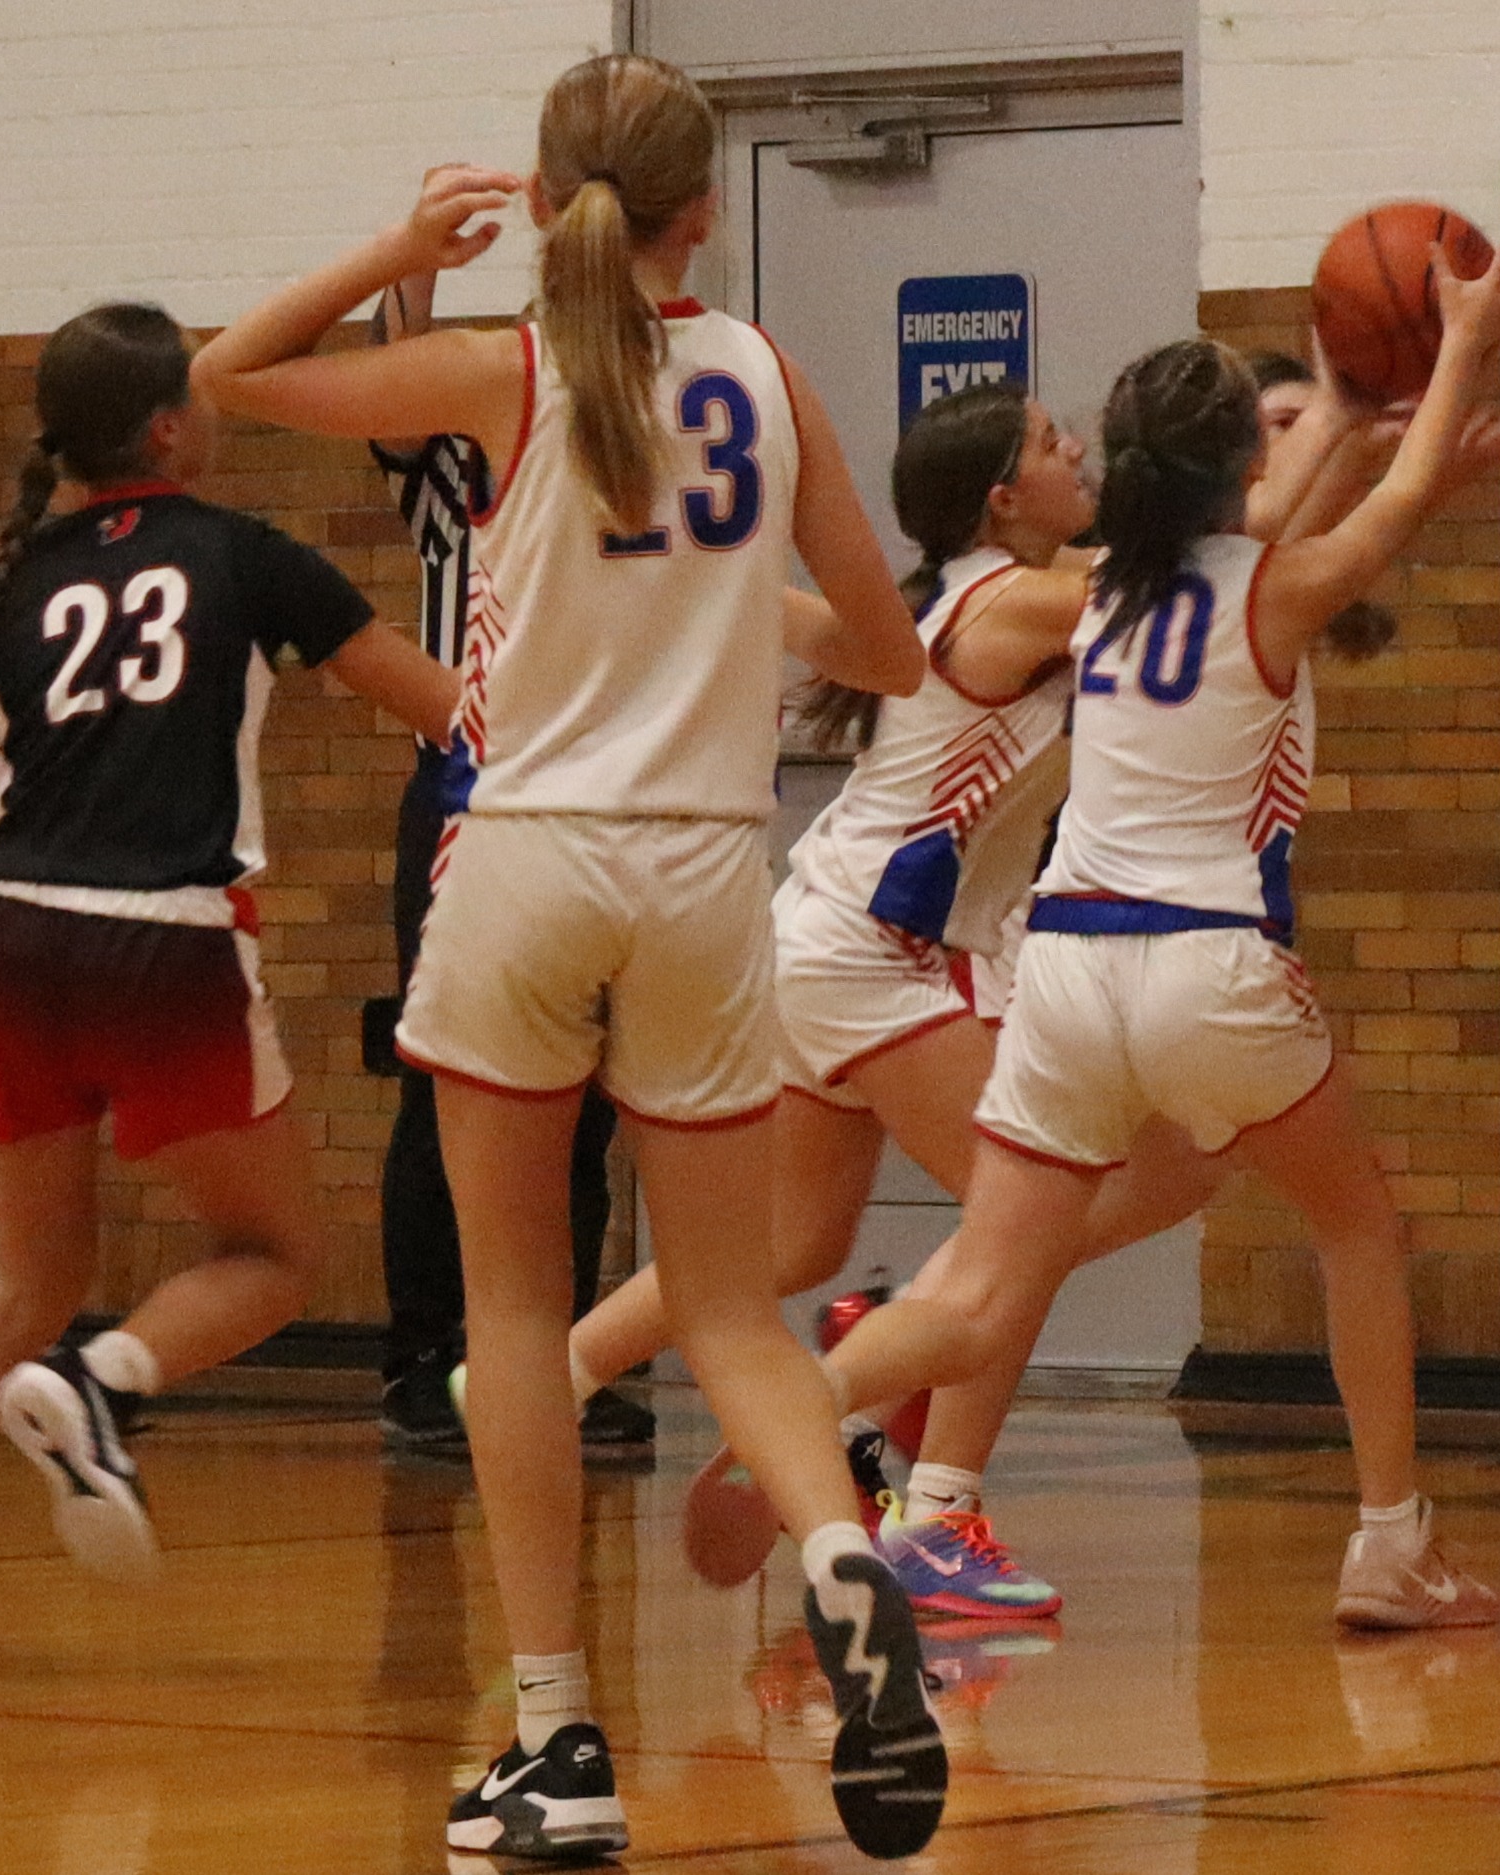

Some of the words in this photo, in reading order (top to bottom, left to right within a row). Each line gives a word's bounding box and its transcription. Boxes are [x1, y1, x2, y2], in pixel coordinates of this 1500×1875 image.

[902, 310, 1023, 344] EMERGENCY
[598, 370, 764, 558] 3
[41, 564, 190, 726] 23
